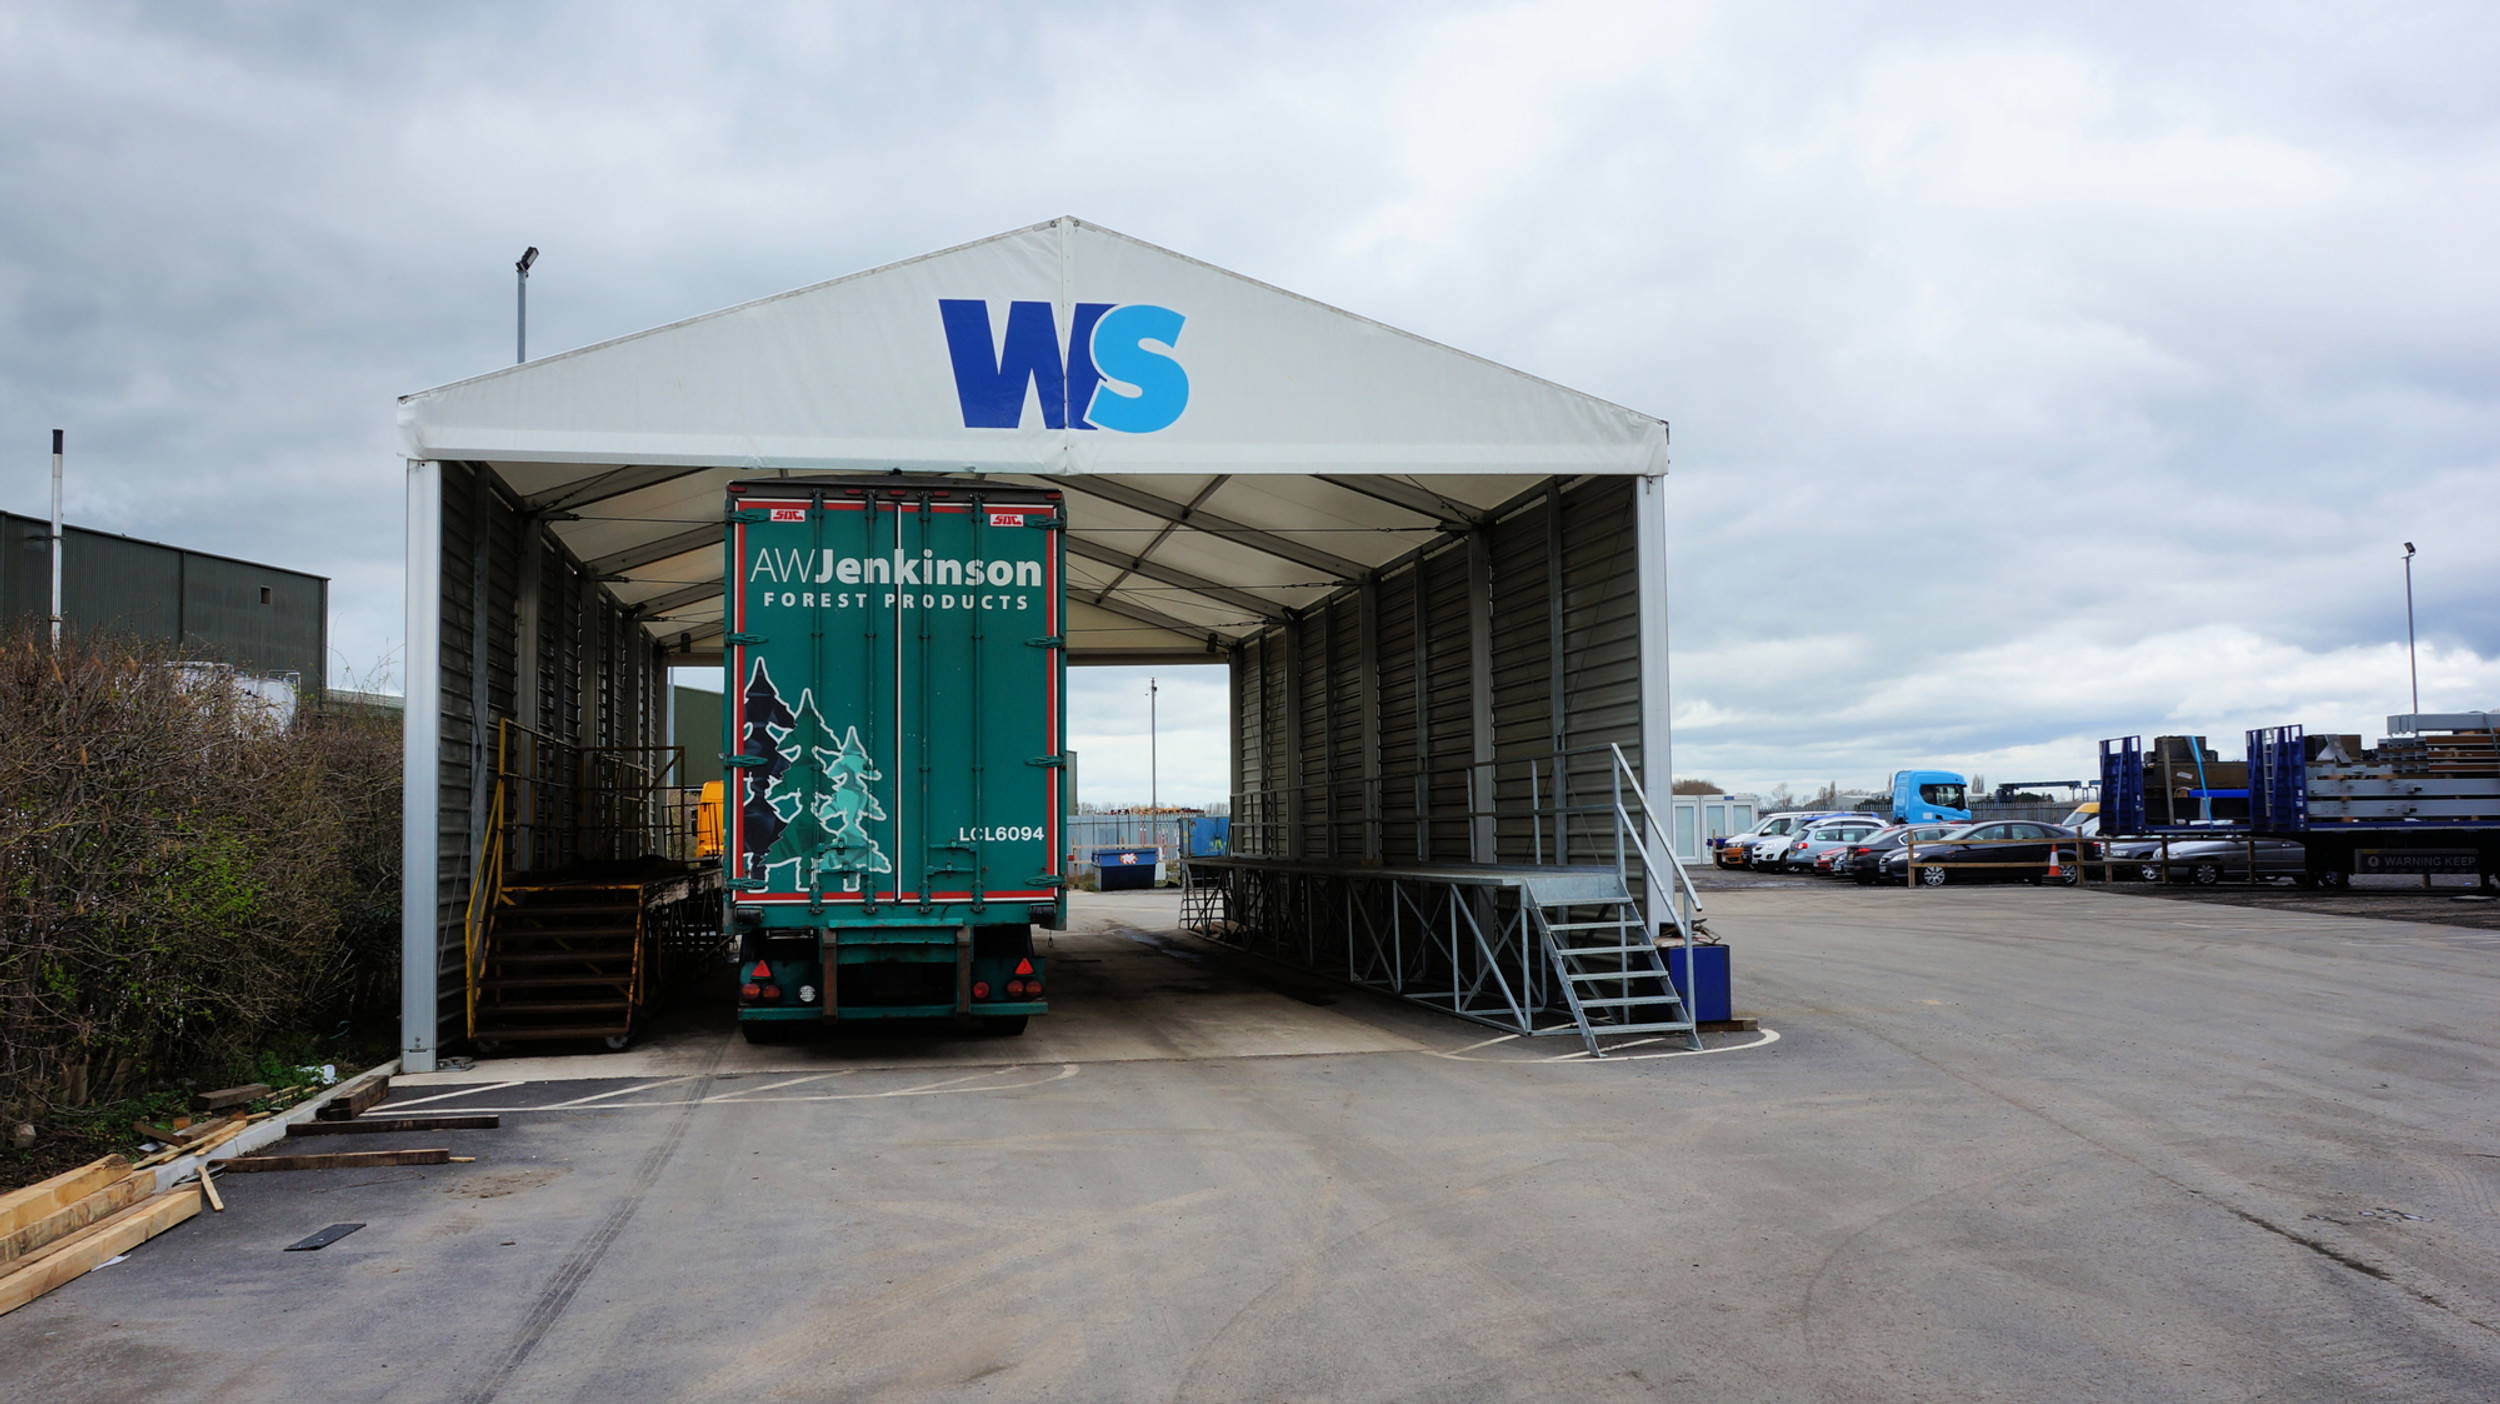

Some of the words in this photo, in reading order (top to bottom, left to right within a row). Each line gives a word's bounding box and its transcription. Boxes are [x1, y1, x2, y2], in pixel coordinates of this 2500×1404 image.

[938, 299, 1190, 434] WS
[763, 592, 867, 608] FOREST
[884, 593, 1028, 610] PRODUCTS
[960, 826, 1045, 841] LCL6094
[2384, 856, 2442, 866] WARNING
[2444, 856, 2477, 866] KEEP
